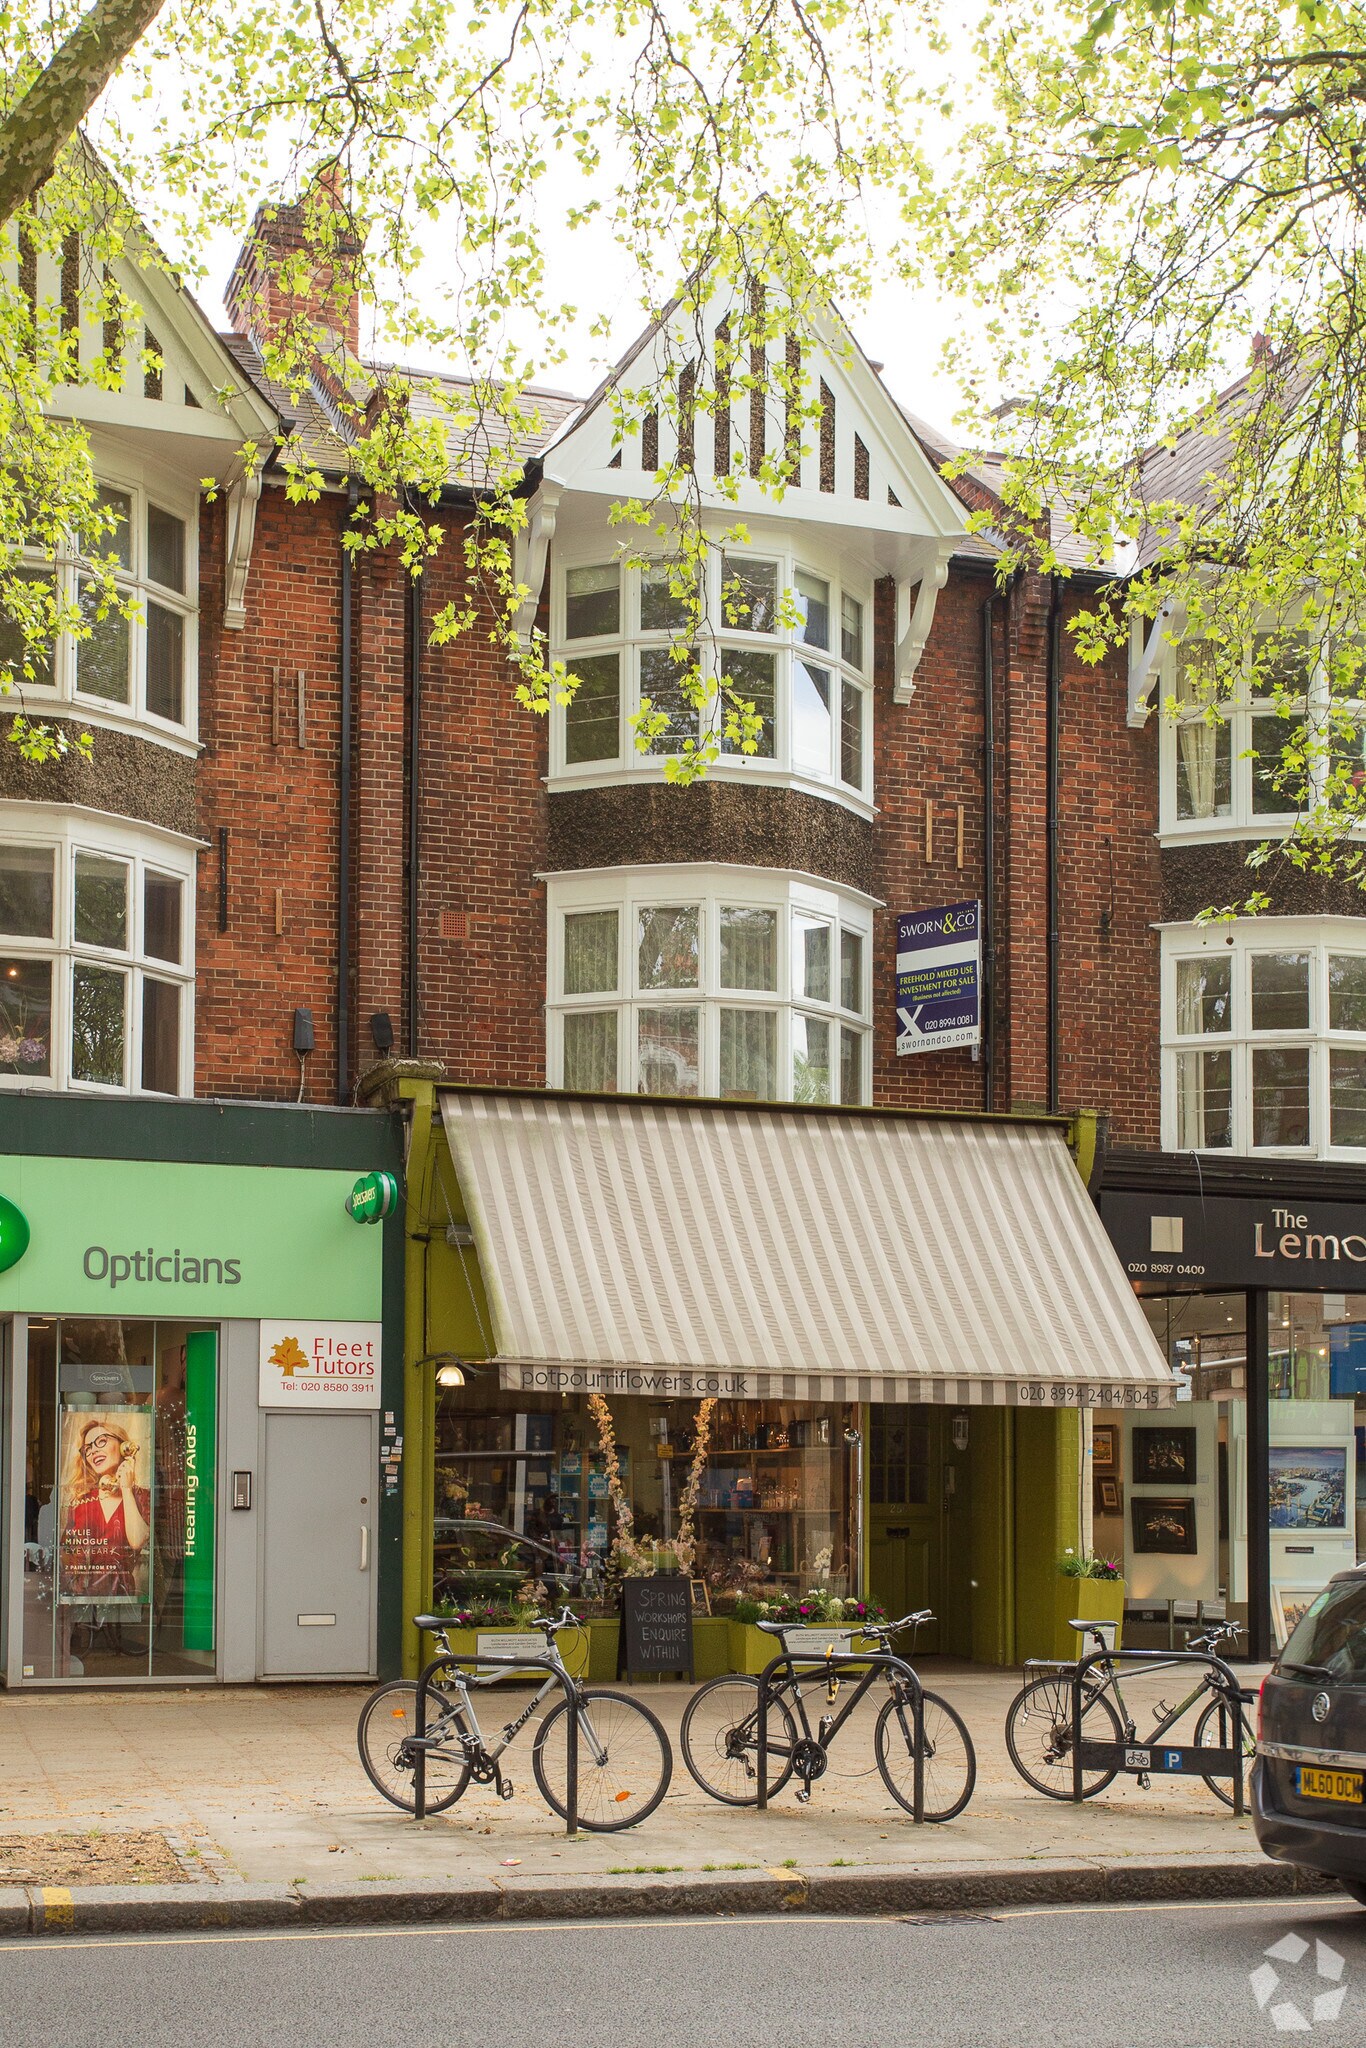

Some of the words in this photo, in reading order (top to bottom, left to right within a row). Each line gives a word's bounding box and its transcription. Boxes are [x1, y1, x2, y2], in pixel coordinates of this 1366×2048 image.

[900, 912, 975, 938] SWORN&CO
[900, 972, 936, 985] FREEHOLD
[937, 968, 959, 979] MIXED
[960, 965, 974, 975] USE
[900, 981, 941, 995] INVESTMENT
[943, 979, 958, 988] FOR
[959, 975, 976, 986] SALE
[925, 1020, 938, 1030] 020
[939, 1017, 956, 1028] 8994
[957, 1014, 973, 1025] 0081
[901, 1031, 973, 1050] swornandco.com
[1271, 1208, 1308, 1229] The
[83, 1246, 242, 1289] Opticians
[1128, 1262, 1147, 1273] 020
[1150, 1263, 1174, 1274] 8987
[1177, 1264, 1205, 1275] 0400
[314, 1338, 374, 1357] Fleet
[312, 1356, 375, 1376] Tutors
[281, 1381, 298, 1391] Tel:
[301, 1382, 321, 1392] 020
[323, 1383, 348, 1392] 8580
[351, 1383, 374, 1393] 3911
[522, 1368, 749, 1393] potpourriflowers.co.uk
[1020, 1386, 1046, 1401] 020
[1050, 1387, 1084, 1401] 8994
[1088, 1388, 1158, 1404] 2404/5045
[186, 1424, 197, 1470] Aids
[185, 1475, 199, 1557] Hearing
[65, 1528, 91, 1536] KYLIE
[65, 1547, 109, 1555] EYEWEAR
[639, 1588, 686, 1607] SPRING
[634, 1609, 687, 1624] WORKSHOPS
[641, 1626, 687, 1642] ENQUIRE
[639, 1644, 680, 1659] WITHIN
[1168, 1752, 1180, 1768] P
[1303, 1771, 1333, 1795] ML60
